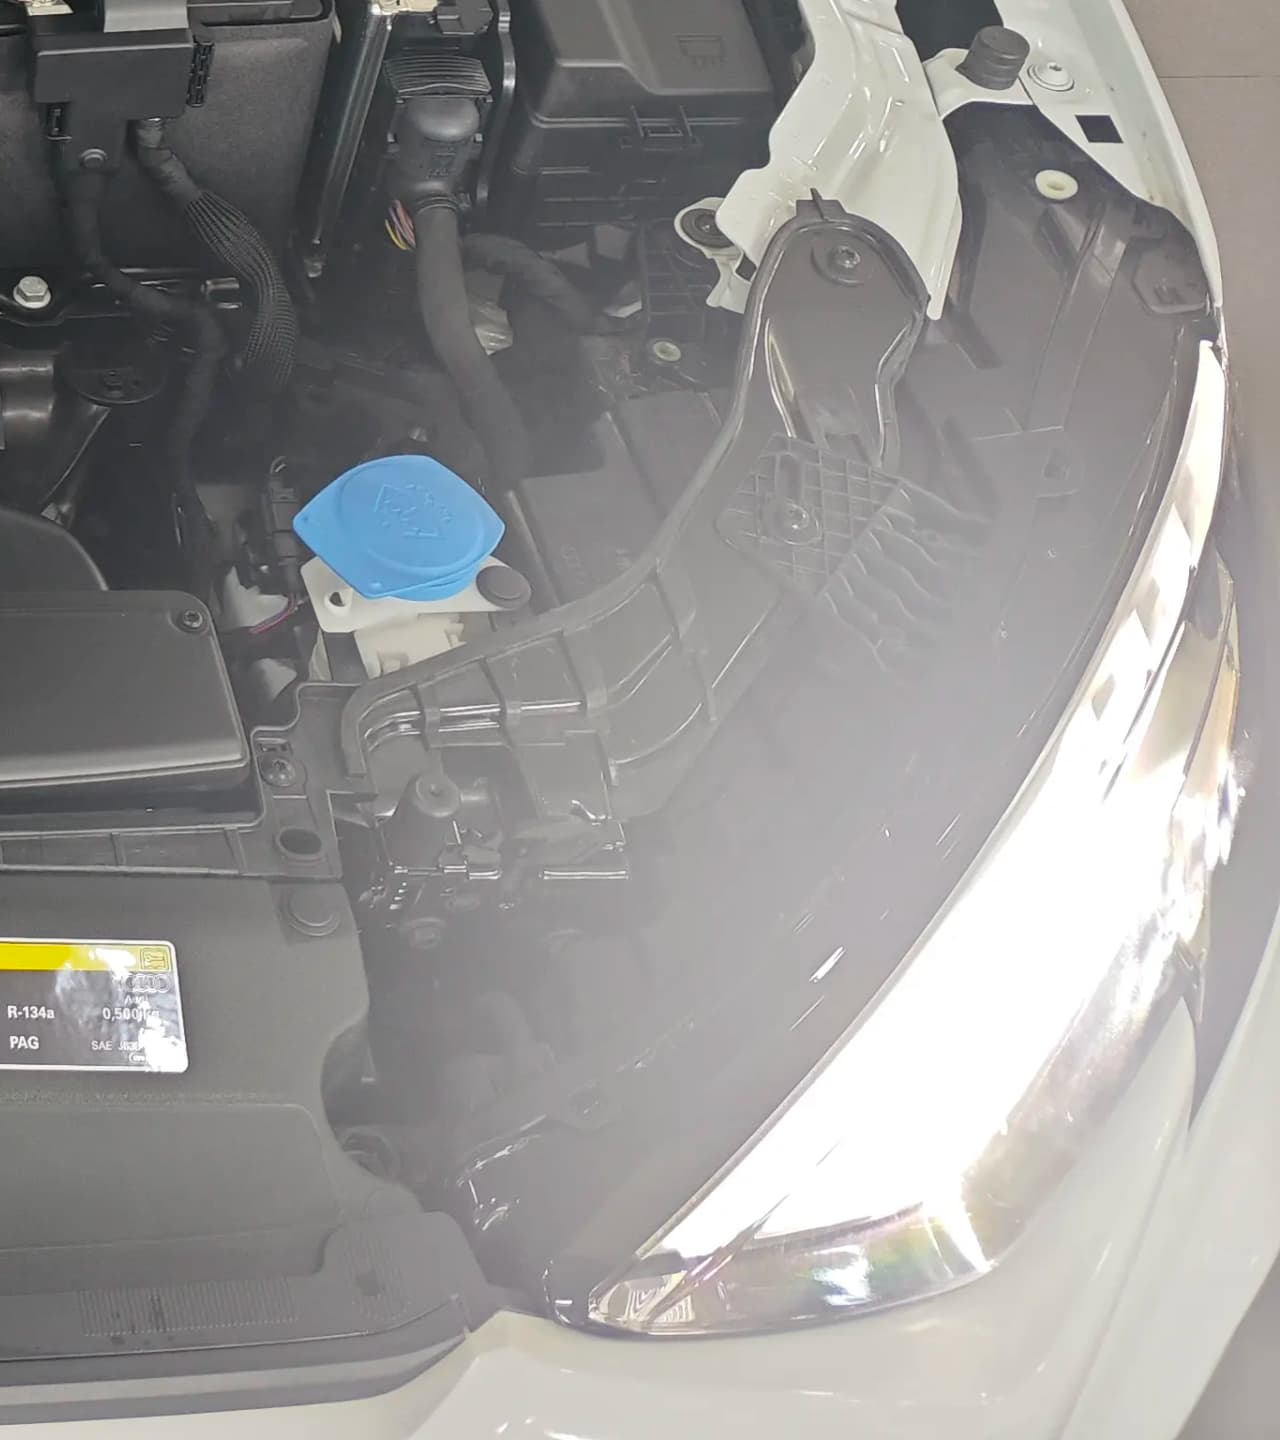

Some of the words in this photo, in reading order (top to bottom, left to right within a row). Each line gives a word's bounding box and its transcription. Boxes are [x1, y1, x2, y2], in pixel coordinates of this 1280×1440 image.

[7, 1005, 55, 1019] R-134a
[10, 1035, 40, 1050] PAG
[91, 1040, 113, 1050] SAE
